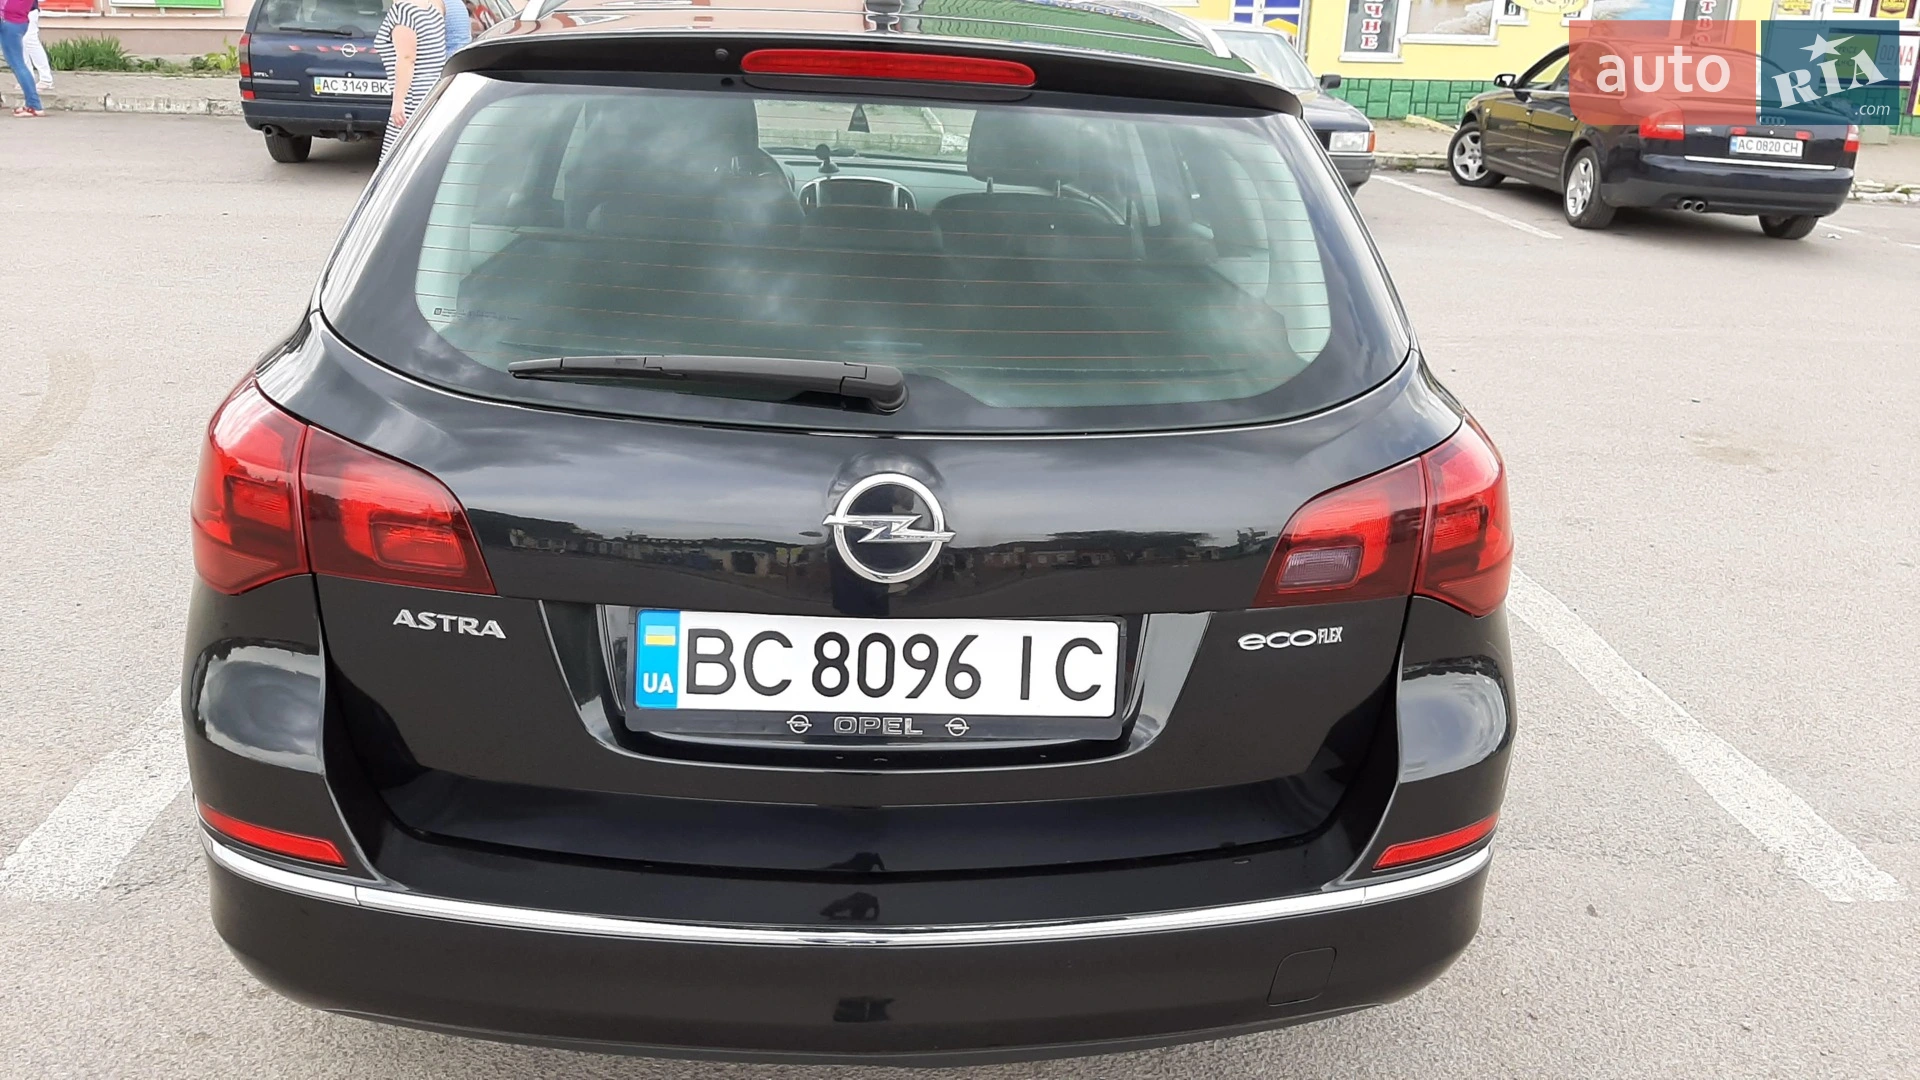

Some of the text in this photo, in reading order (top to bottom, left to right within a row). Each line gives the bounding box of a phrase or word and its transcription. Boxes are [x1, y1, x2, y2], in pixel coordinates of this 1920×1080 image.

[1361, 0, 1383, 49] ЧНЕ
[322, 80, 388, 93] AC 3149 BK
[1738, 140, 1798, 153] AC 0820 CH
[393, 608, 507, 639] ASTRA
[686, 628, 793, 696] BC
[811, 631, 982, 700] 8096
[643, 673, 674, 694] UA
[833, 716, 924, 735] OPEL
